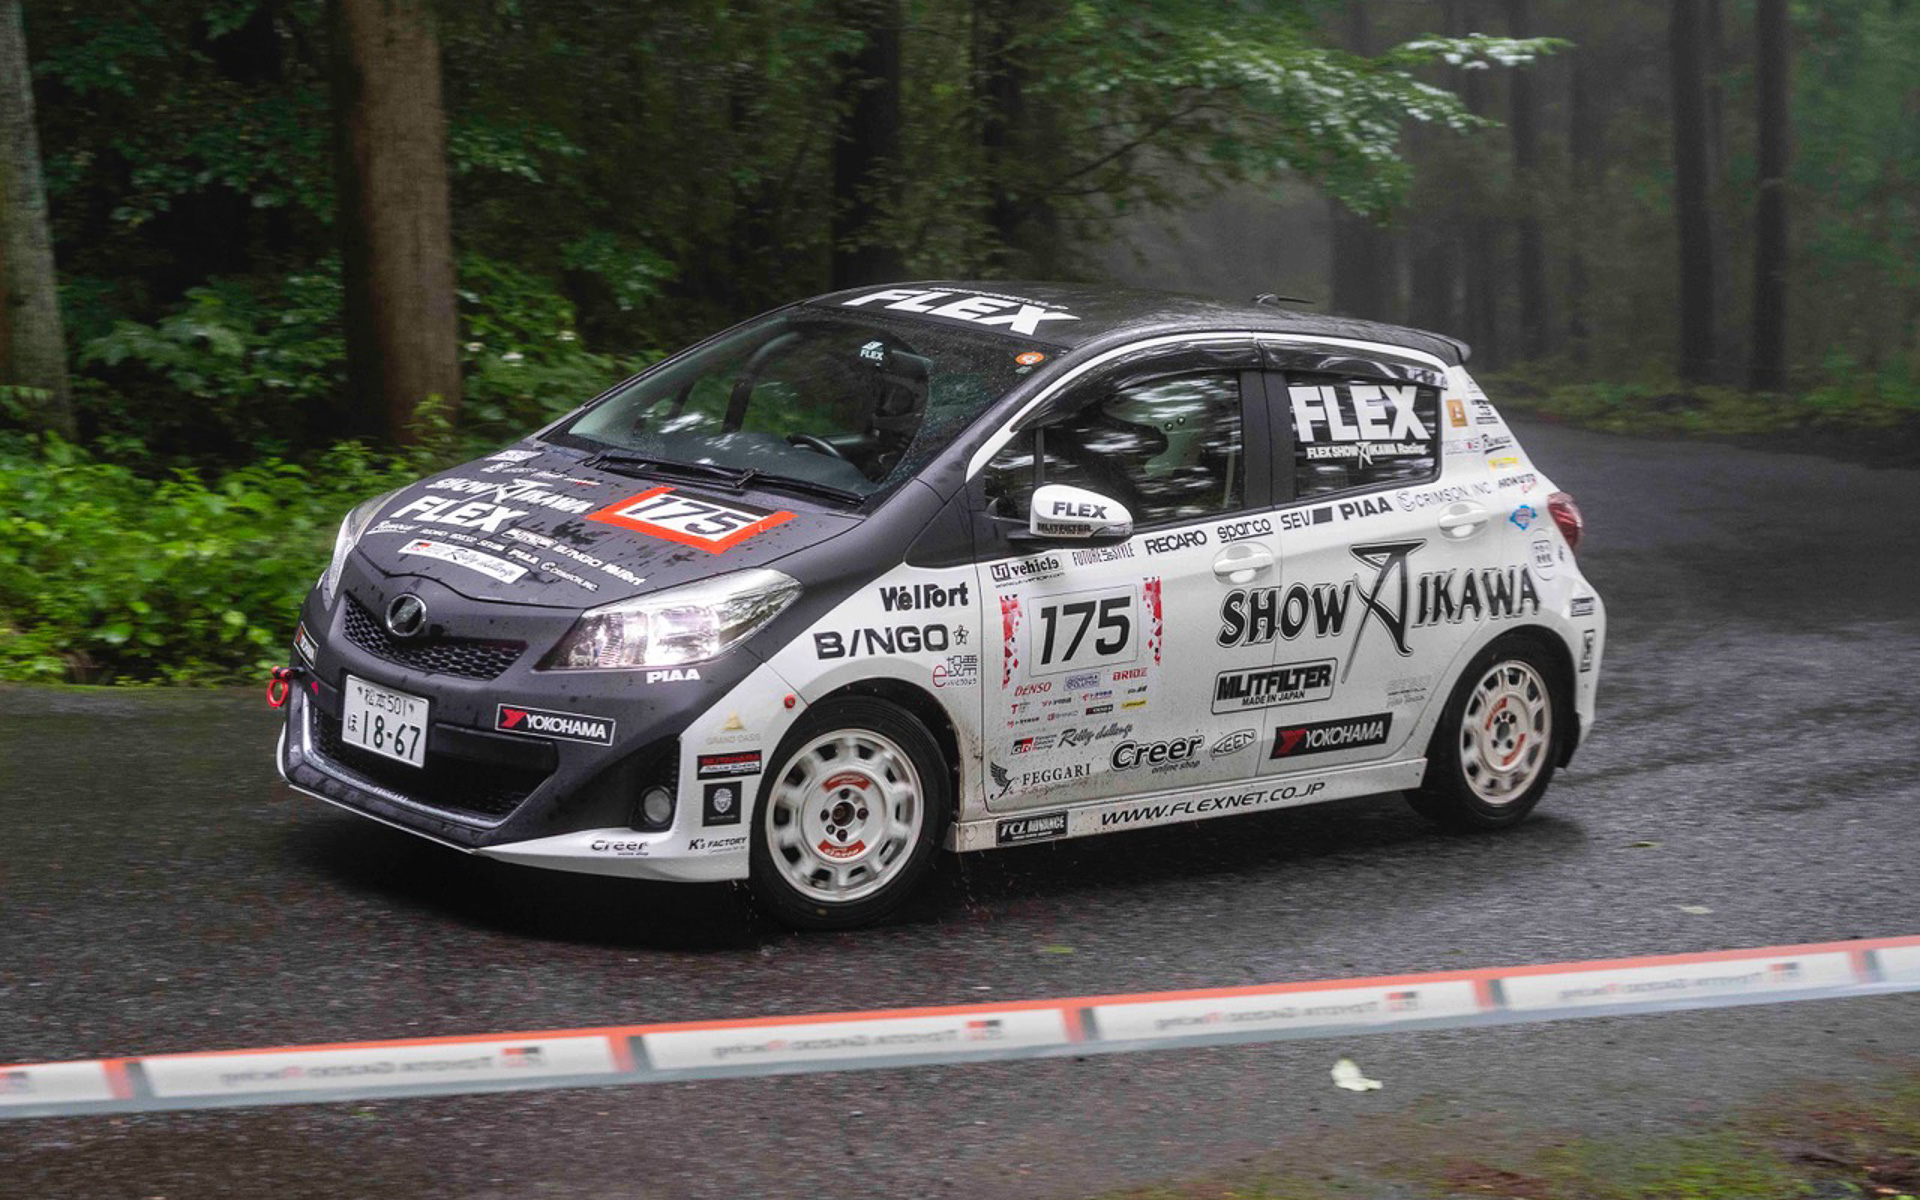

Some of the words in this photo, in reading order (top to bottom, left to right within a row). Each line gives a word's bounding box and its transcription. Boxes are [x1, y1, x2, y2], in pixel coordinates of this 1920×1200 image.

[841, 289, 1080, 335] FLEX
[1288, 385, 1431, 442] FLEX
[388, 495, 529, 533] FLEX
[626, 496, 757, 534] 175
[1052, 501, 1107, 519] FLEX
[1338, 496, 1394, 520] PIAA
[1217, 518, 1271, 541] sparco
[1145, 530, 1207, 555] RECARO
[1011, 557, 1060, 576] vehicle
[1216, 581, 1356, 648] SHOW
[1040, 596, 1131, 665] 175
[646, 668, 700, 684] PIAA
[1113, 667, 1148, 681] BRIDE
[1014, 681, 1052, 697] DENSO
[1242, 695, 1265, 706] MADE
[1266, 693, 1277, 703] IN
[1278, 690, 1305, 702] JAPAN
[526, 713, 606, 739] YOKOHAMA
[1306, 721, 1384, 747] YOKOHAMA
[1111, 735, 1203, 771] Creer
[1213, 731, 1255, 754] KEEN
[1023, 763, 1091, 786] FEGGARI
[591, 840, 646, 851] Creer
[707, 836, 748, 849] FACTORY
